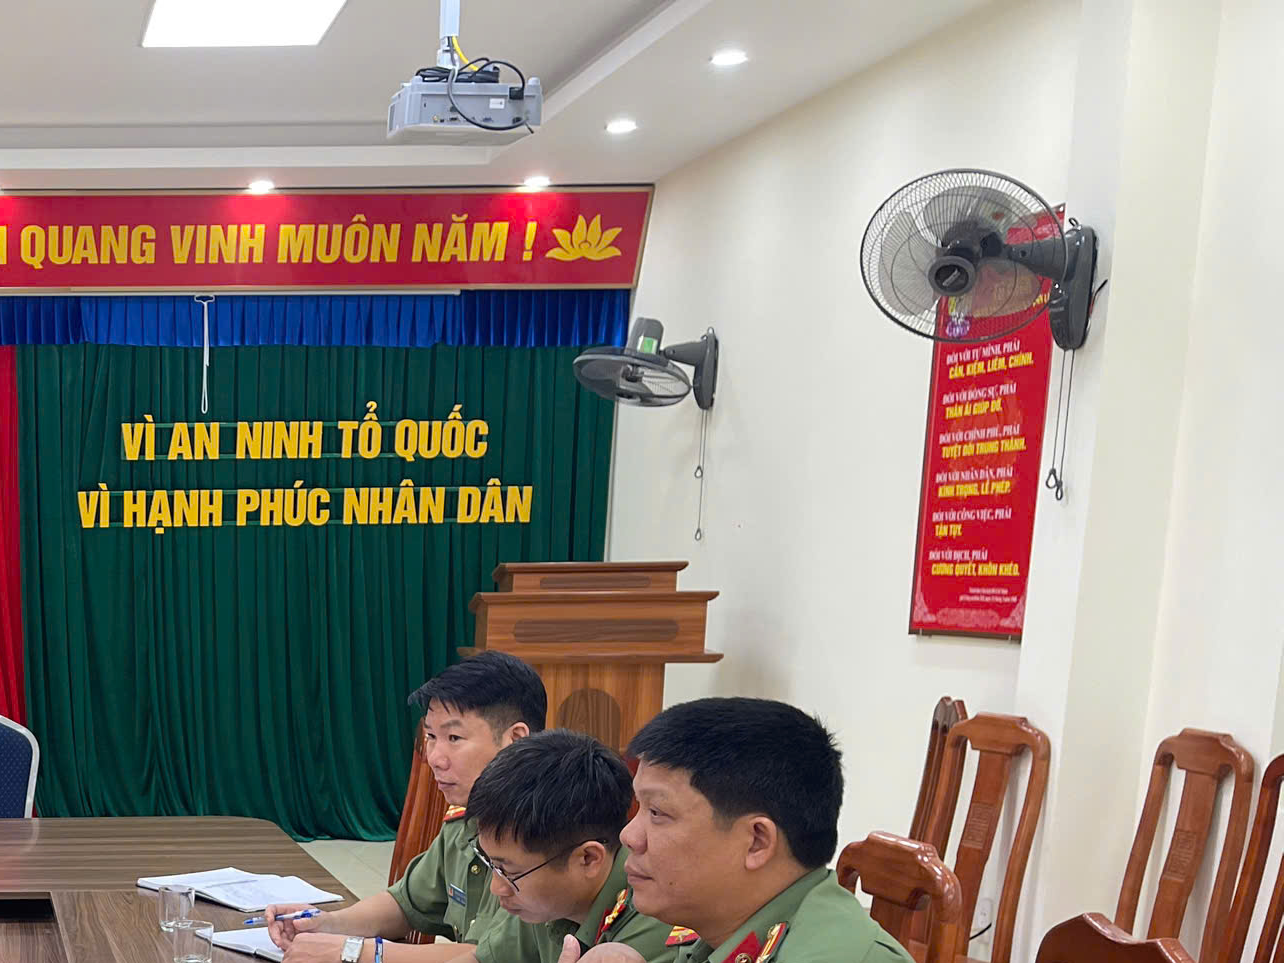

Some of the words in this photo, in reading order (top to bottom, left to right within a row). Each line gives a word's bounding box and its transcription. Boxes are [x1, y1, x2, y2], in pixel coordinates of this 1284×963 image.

[20, 225, 156, 269] QUANG
[171, 224, 265, 265] VINH
[277, 215, 401, 265] MUÔN
[411, 214, 508, 263] NĂM
[121, 415, 155, 461] VÌ
[167, 421, 220, 461] AN
[235, 420, 323, 460] NINH
[338, 401, 383, 459] TỔ
[395, 405, 489, 461] QUỐC
[77, 482, 110, 529] VÌ
[123, 489, 223, 535] HẠNH
[235, 480, 330, 527] PHÚC
[343, 479, 445, 525] NHÂN
[456, 479, 533, 524] DÂN
